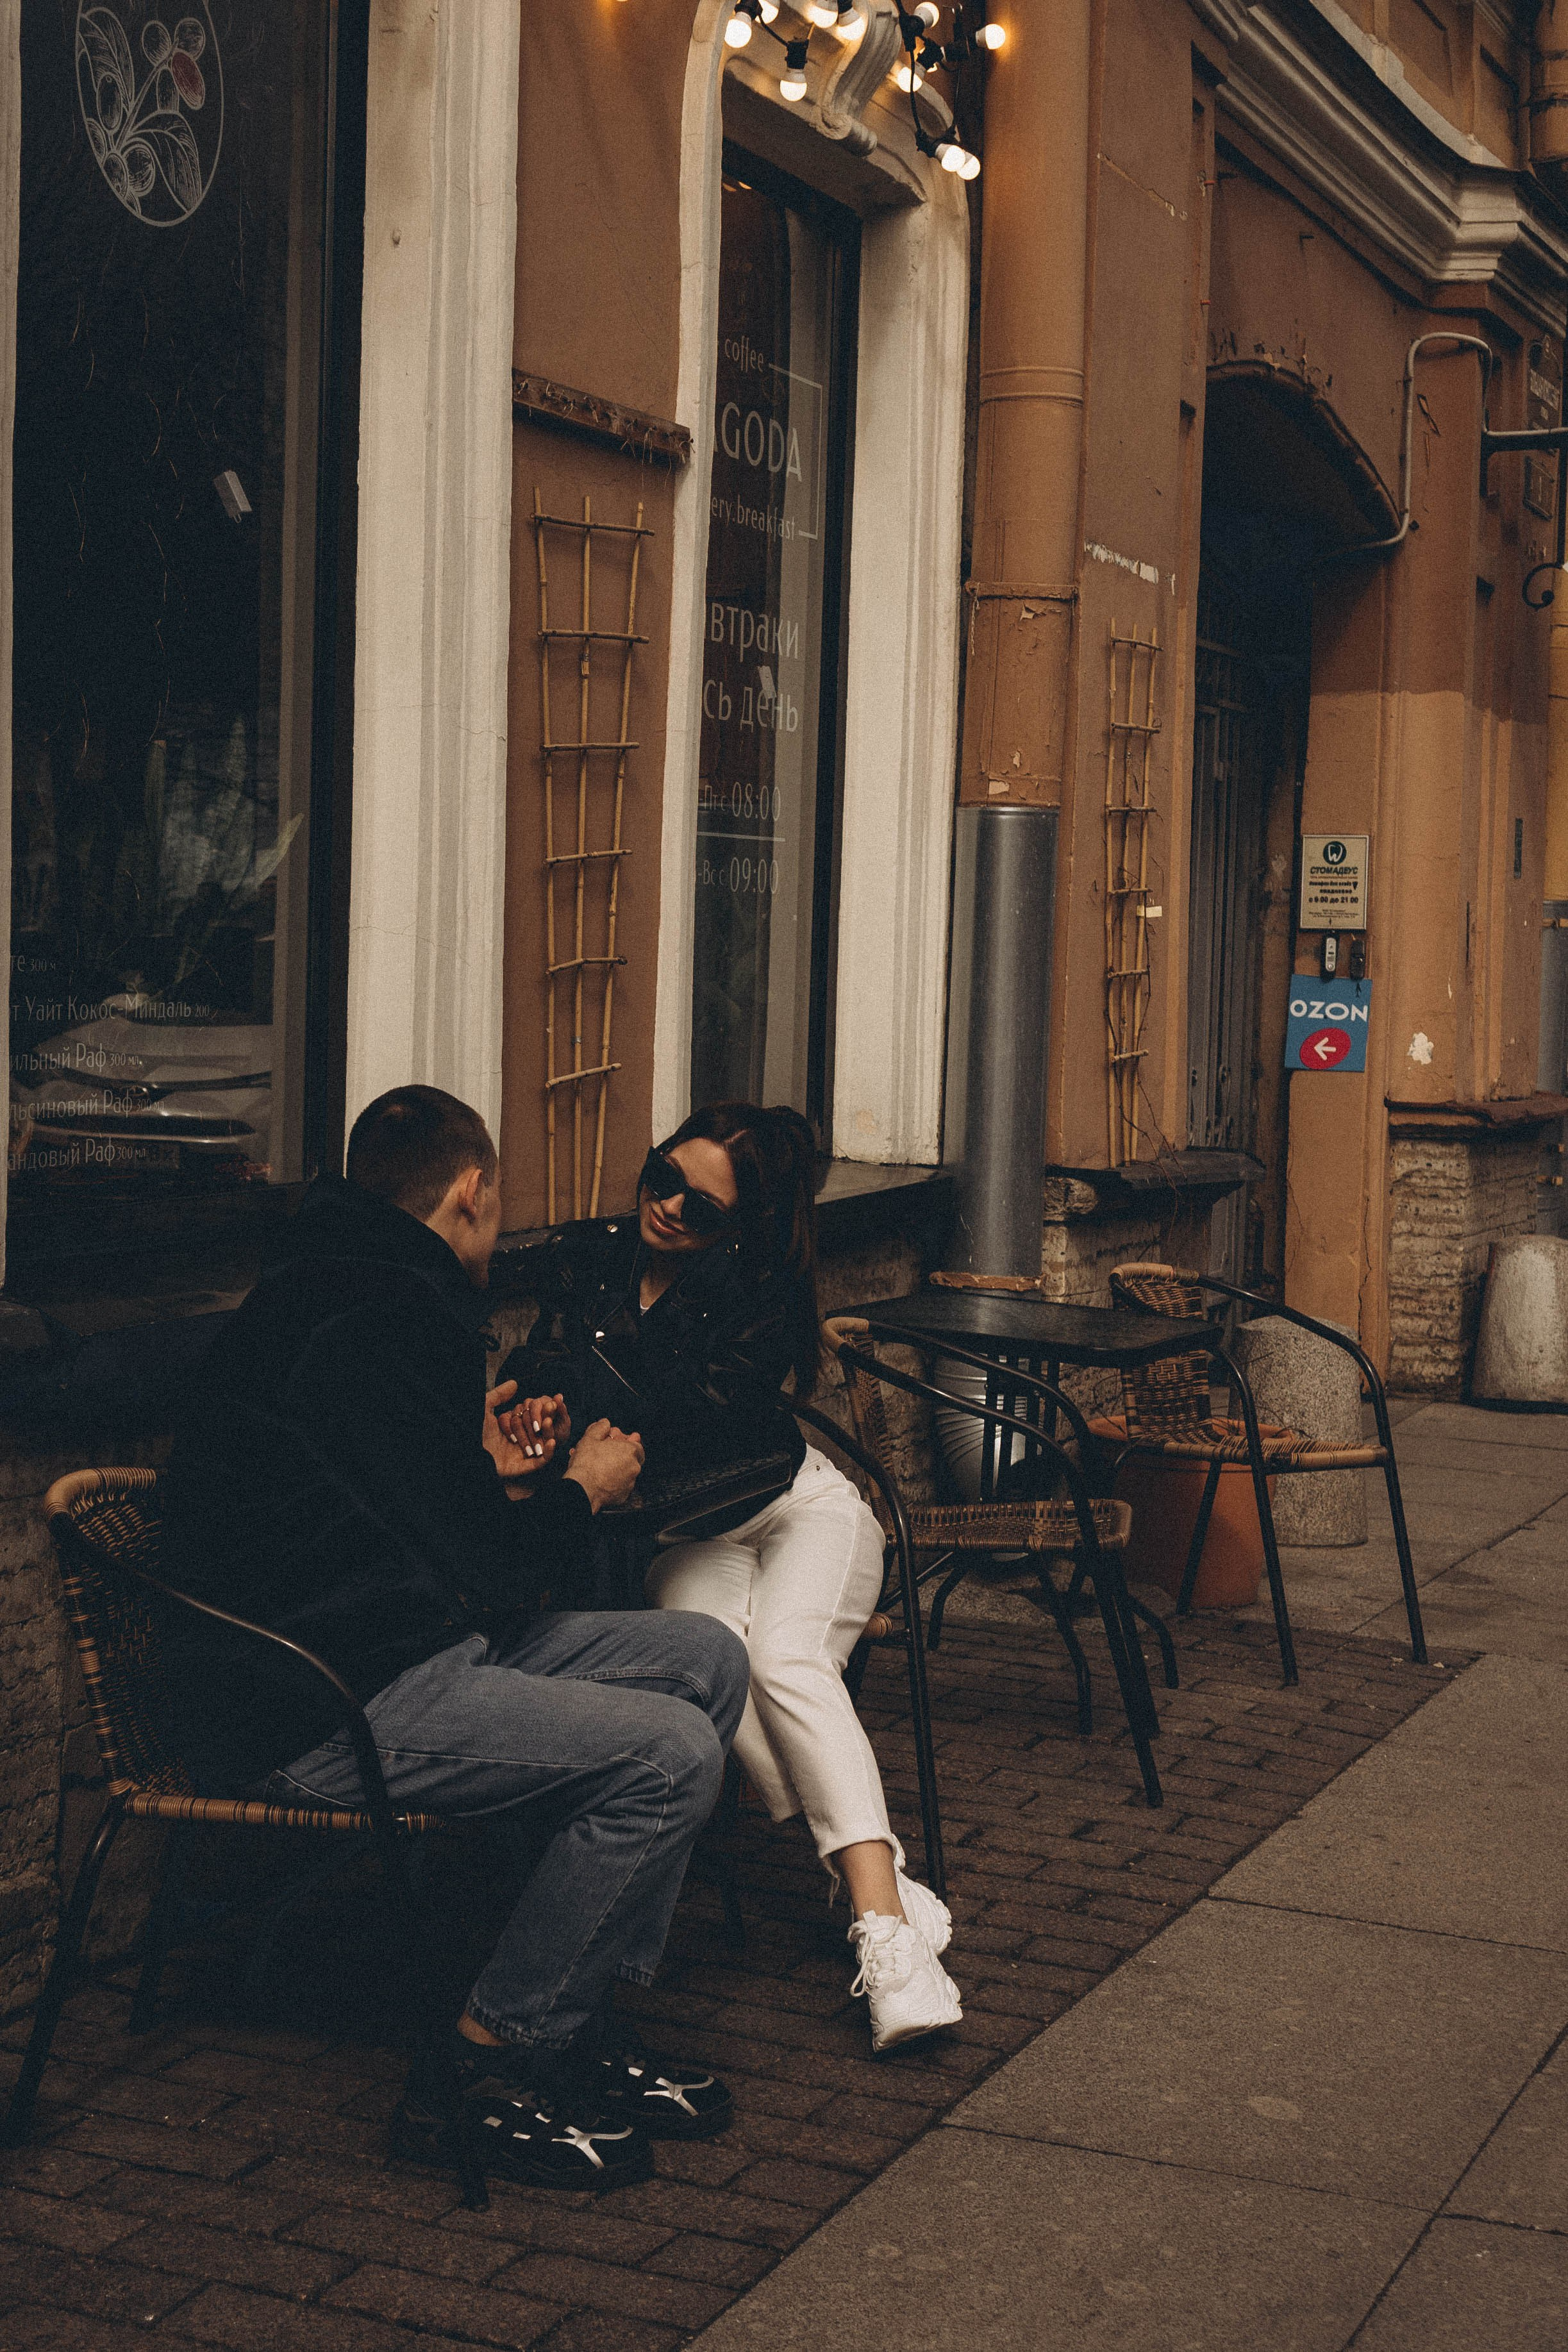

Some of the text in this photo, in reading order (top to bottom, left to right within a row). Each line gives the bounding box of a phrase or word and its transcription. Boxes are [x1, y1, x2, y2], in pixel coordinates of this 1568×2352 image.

[724, 335, 763, 372] coffee
[715, 401, 802, 482] GODA
[740, 686, 797, 733] день
[732, 781, 781, 821] 08:00
[730, 857, 779, 894] 09:00
[1310, 866, 1358, 876] СТОМАДЕУС
[25, 996, 63, 1022] Уайт
[67, 994, 192, 1021] Кокос-Миндаль
[1290, 999, 1368, 1022] OZON
[76, 1042, 106, 1073] Раф
[110, 1053, 126, 1065] 300
[103, 1089, 133, 1118] Раф
[85, 1137, 115, 1167] Раф
[116, 1146, 133, 1160] 300
